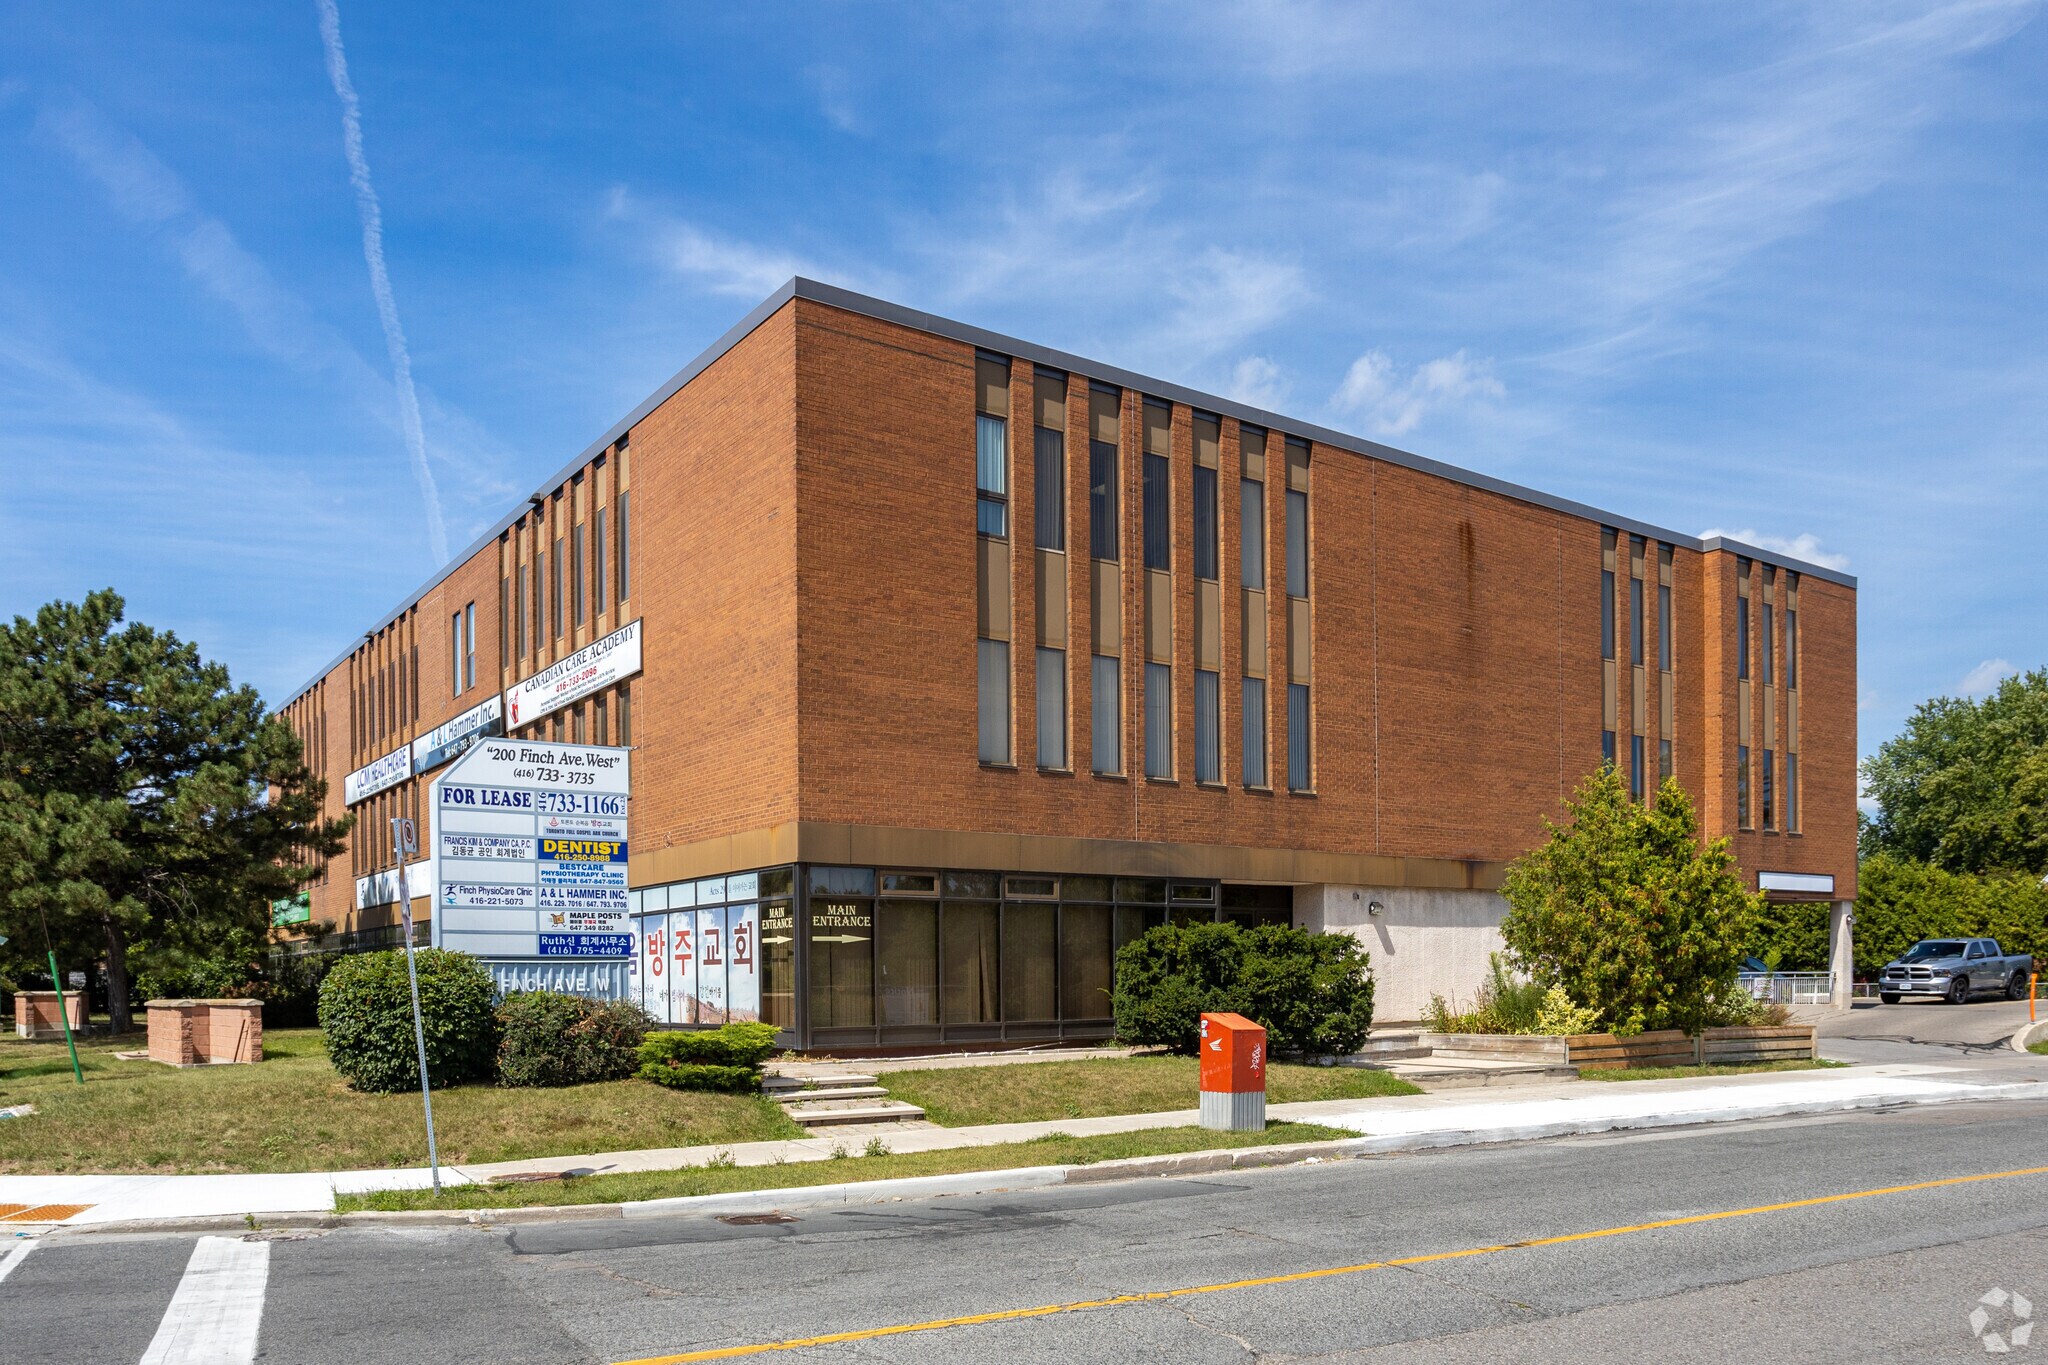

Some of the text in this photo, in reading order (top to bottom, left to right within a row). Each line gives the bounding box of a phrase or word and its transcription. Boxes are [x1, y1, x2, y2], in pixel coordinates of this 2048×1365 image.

[525, 662, 564, 692] CANADIAN
[566, 650, 587, 671] CARE
[590, 625, 635, 659] ACADEMY
[556, 666, 597, 693] 416-733-2096
[431, 704, 494, 750] A & L Hammer Inc.
[520, 748, 555, 765] Finch
[357, 748, 406, 788] LCM HEALTHCARE
[513, 768, 534, 778] (416)
[443, 788, 531, 808] FOR LEASE
[538, 792, 546, 812] 416
[548, 793, 619, 815] 733-1166
[444, 836, 467, 845] FRANCIS
[468, 837, 478, 846] KIM
[478, 838, 483, 846] &
[483, 838, 510, 847] COMPANY
[521, 840, 532, 849] P.C.
[544, 840, 621, 854] DENTIST
[452, 846, 525, 858] 김동균 공인 회계법인
[554, 853, 610, 862] 416-250-8988
[559, 863, 604, 871] BESTCARE
[541, 870, 600, 878] PHYSIOTHERAPY
[459, 885, 533, 897] Finch PhysioCare Clinic
[540, 888, 627, 900] A & L HAMMER INC.
[469, 897, 524, 905] 416-221-5073
[570, 912, 622, 920] MAPLE POSTS
[769, 907, 785, 918] MAIN
[827, 905, 856, 916] MAIN
[762, 917, 793, 930] ENTRANCE
[813, 916, 871, 927] ENTRANCE
[541, 936, 628, 946] Ruth신 회계사무소
[548, 946, 622, 955] (416) 795-4409
[502, 978, 610, 992] FINCH AVE. W
